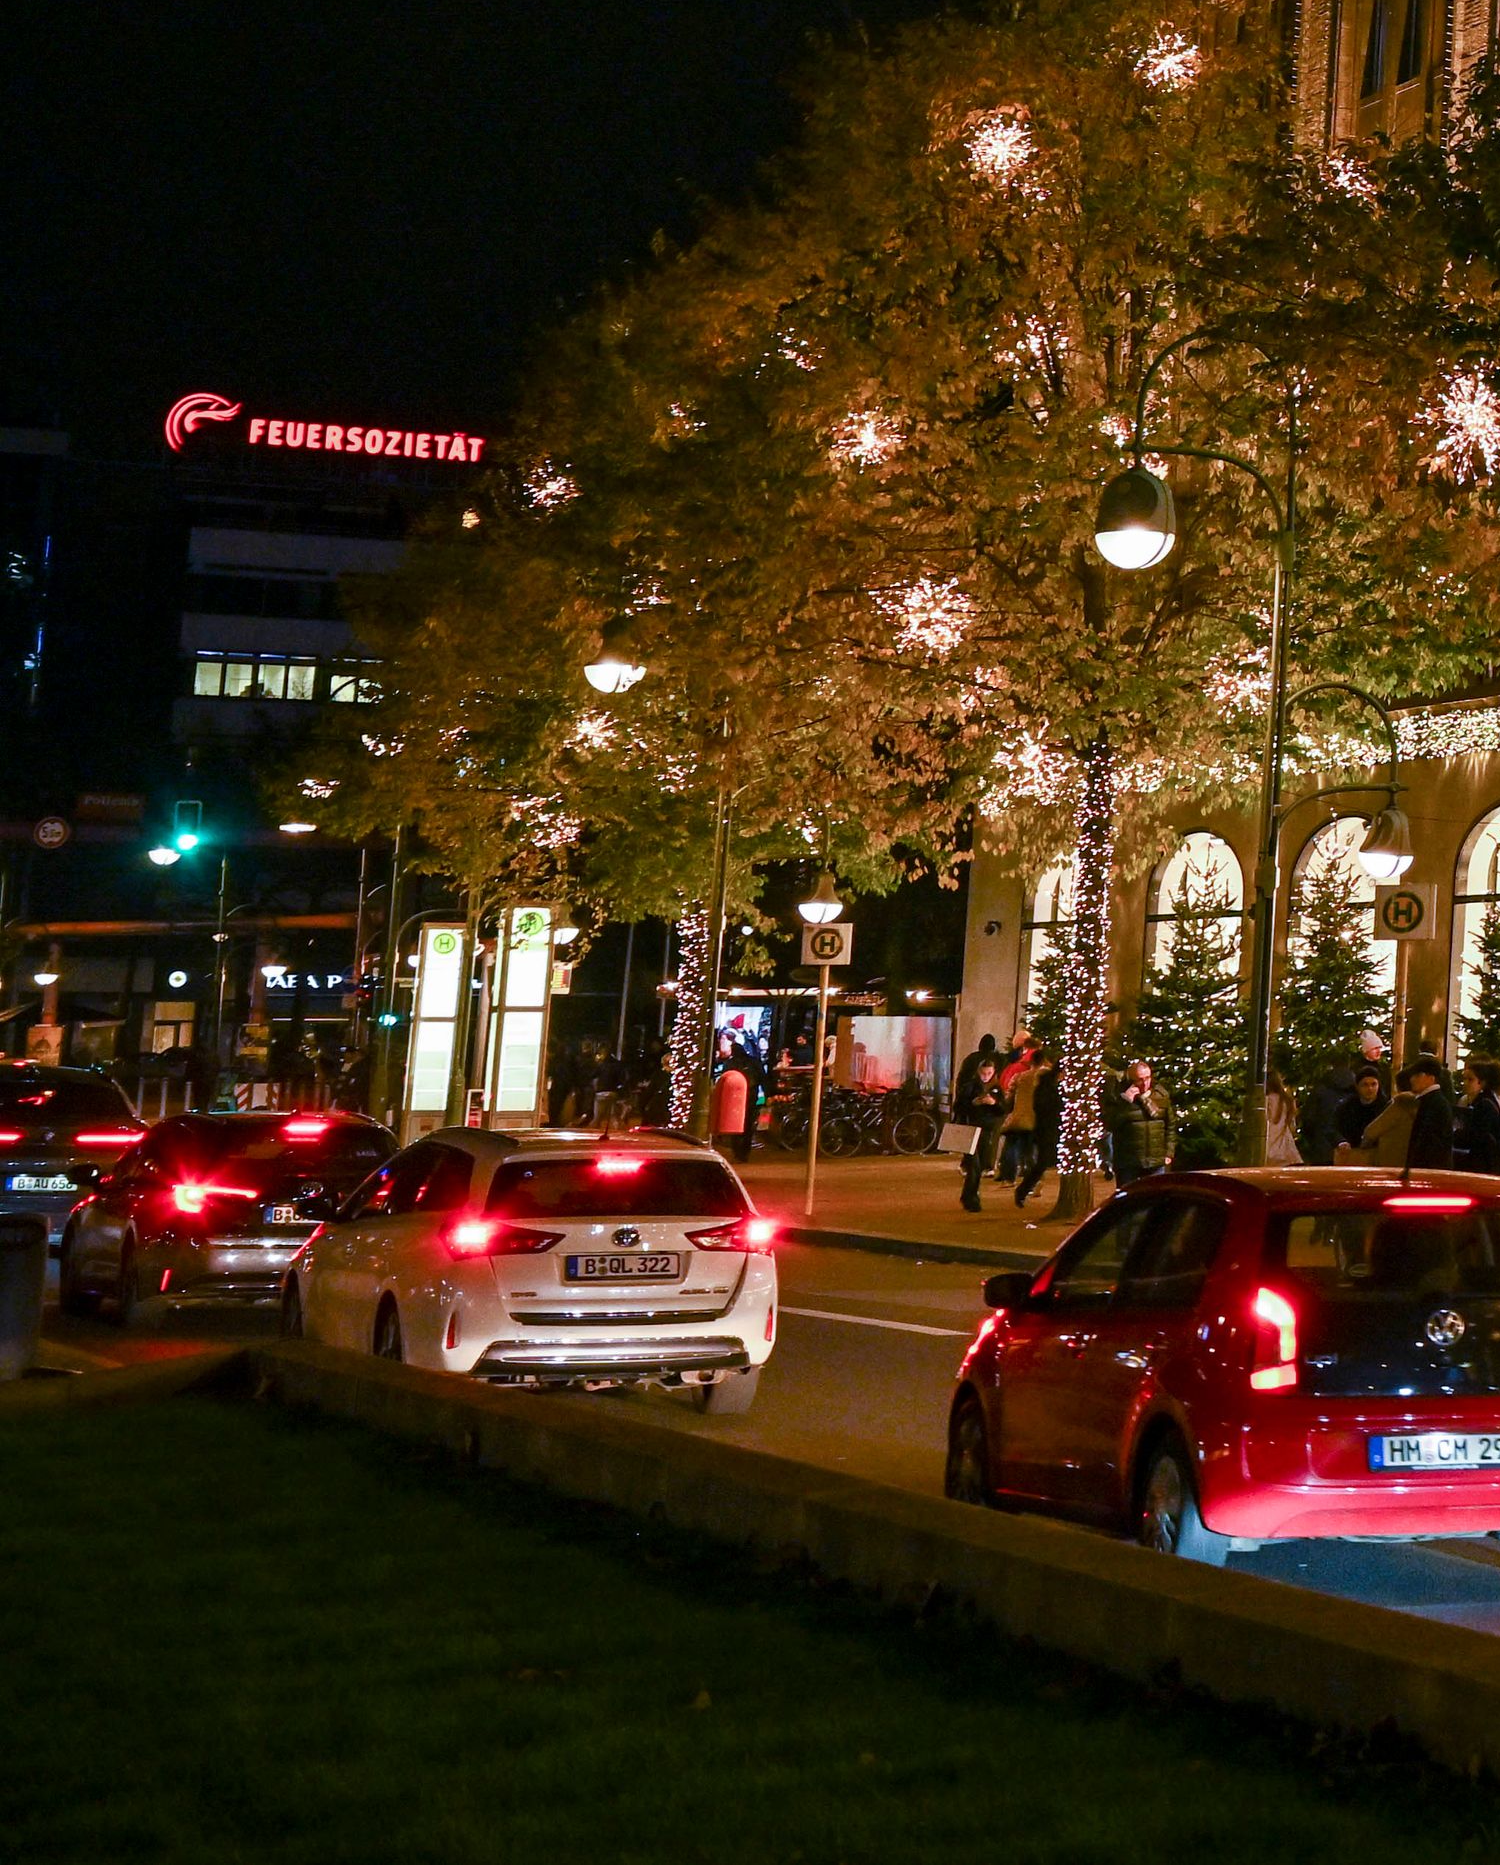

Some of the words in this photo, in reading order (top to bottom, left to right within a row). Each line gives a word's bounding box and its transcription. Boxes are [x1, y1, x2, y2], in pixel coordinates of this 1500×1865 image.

[249, 418, 484, 462] FEUERSOZIETÄT
[17, 1178, 26, 1189] B
[34, 1178, 48, 1189] AU
[584, 1259, 597, 1274] B
[609, 1258, 633, 1274] QL
[637, 1257, 670, 1273] 322
[1390, 1439, 1422, 1462] HM
[1437, 1439, 1468, 1461] CM
